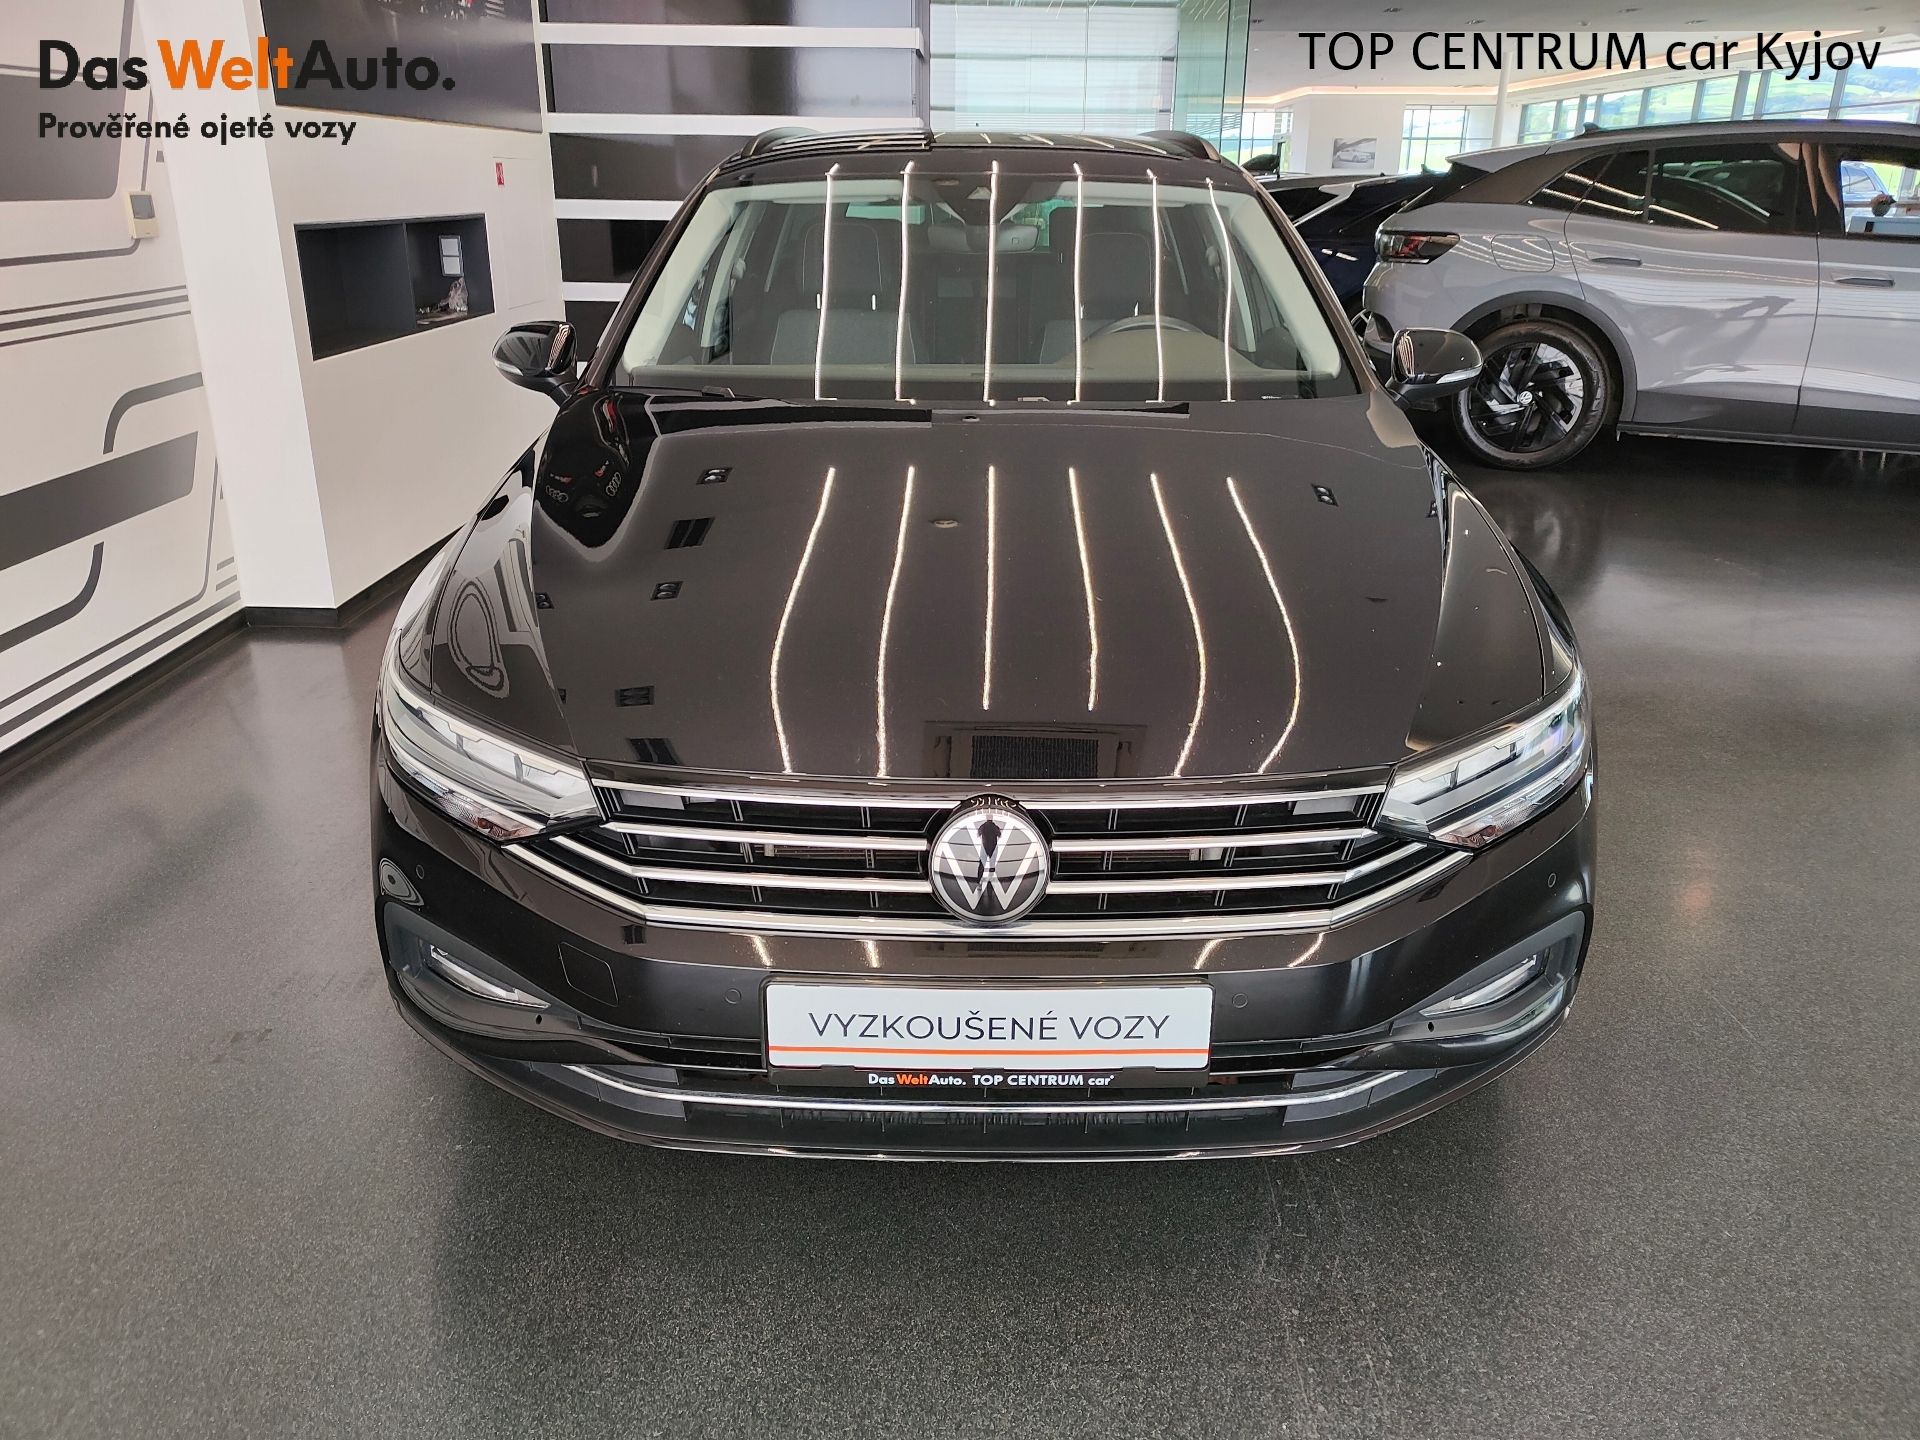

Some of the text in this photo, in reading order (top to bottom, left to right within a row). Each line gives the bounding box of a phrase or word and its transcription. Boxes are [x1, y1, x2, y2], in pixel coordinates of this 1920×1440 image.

[808, 1010, 1171, 1041] VYZKOUŠENÉ VOZY
[868, 1073, 896, 1085] Das
[896, 1073, 967, 1086] WeltAuto.
[972, 1074, 1004, 1086] TOP
[1007, 1074, 1084, 1086] CENTRUM
